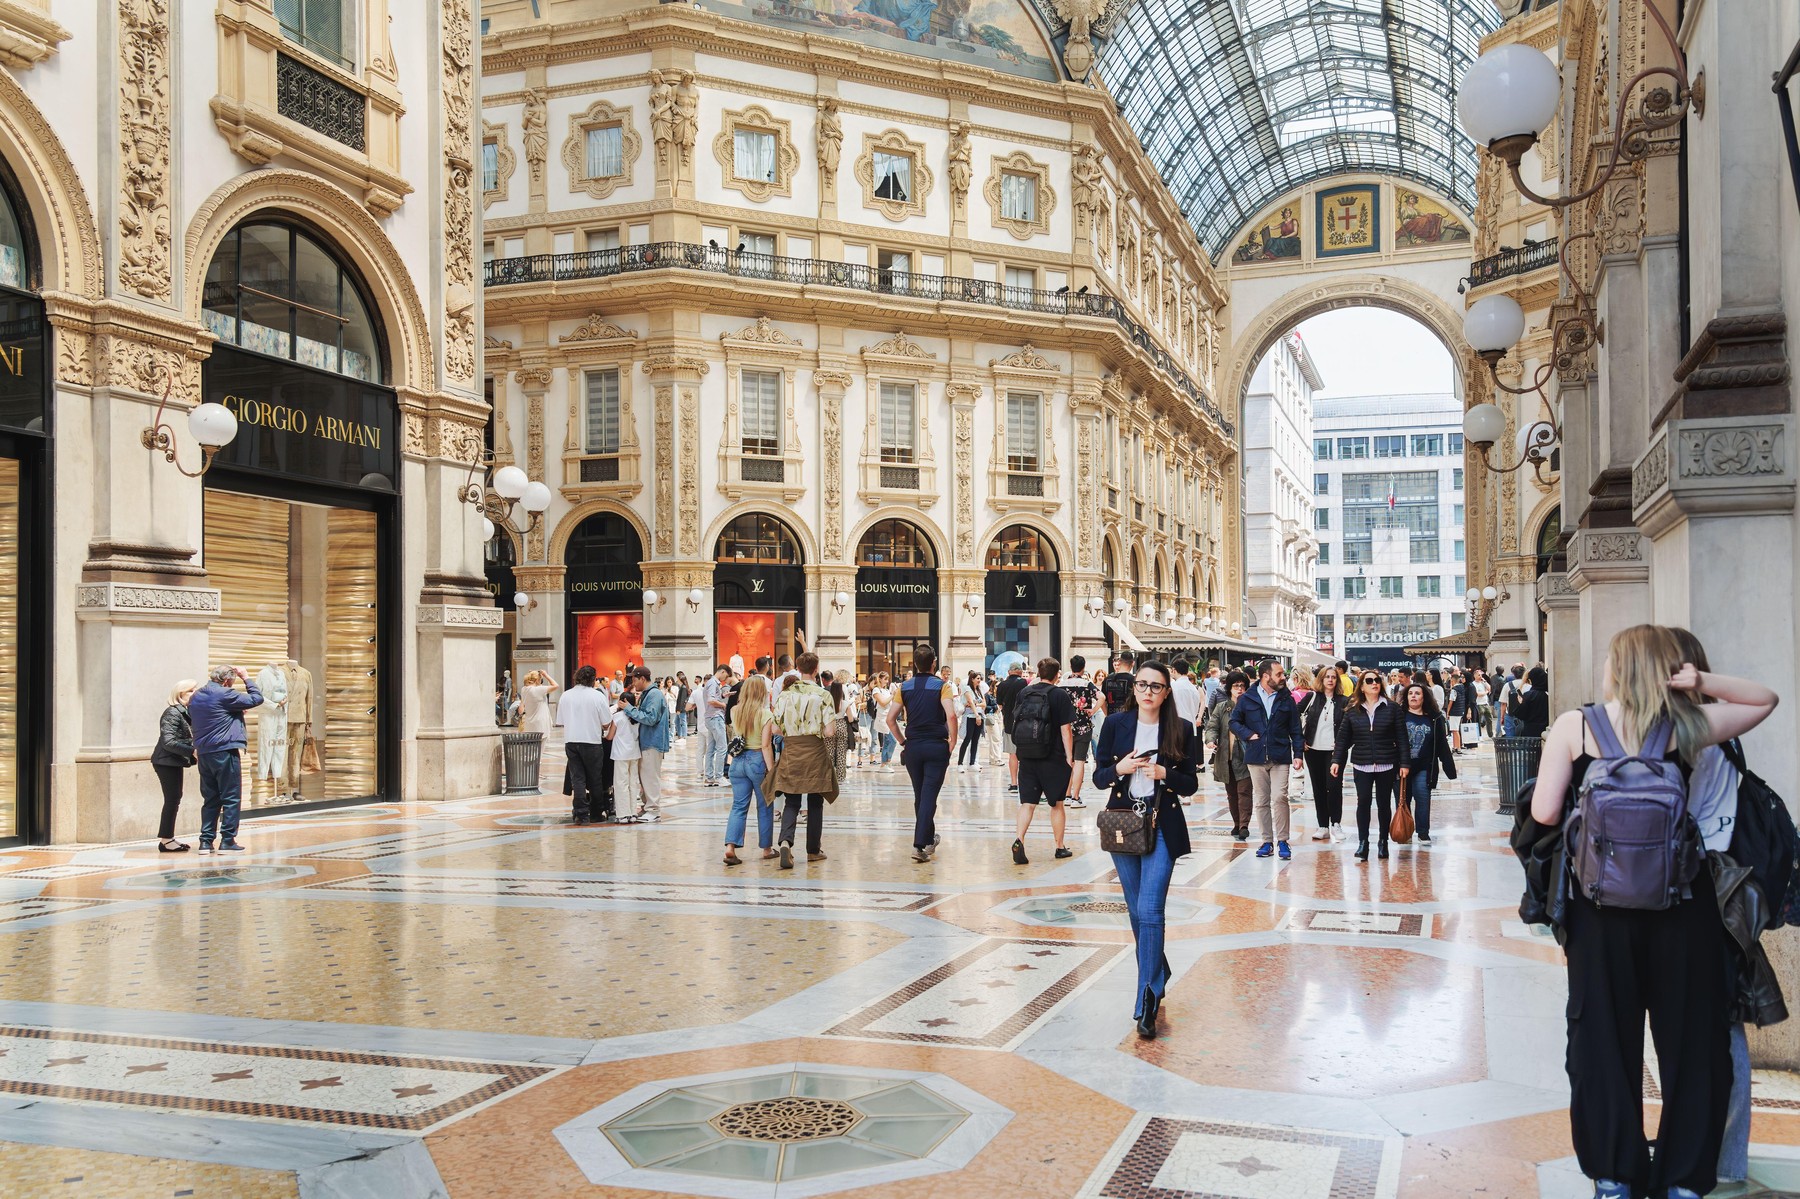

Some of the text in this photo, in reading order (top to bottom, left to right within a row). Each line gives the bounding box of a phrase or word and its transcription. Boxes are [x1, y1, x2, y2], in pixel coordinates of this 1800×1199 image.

[223, 395, 381, 450] GIORGIO ARMANI
[486, 582, 500, 596] DI
[571, 580, 642, 592] LOUIS VUITTON
[860, 583, 930, 594] LOUIS VUITTON
[1345, 631, 1438, 643] McDonald's
[1718, 816, 1736, 832] P
